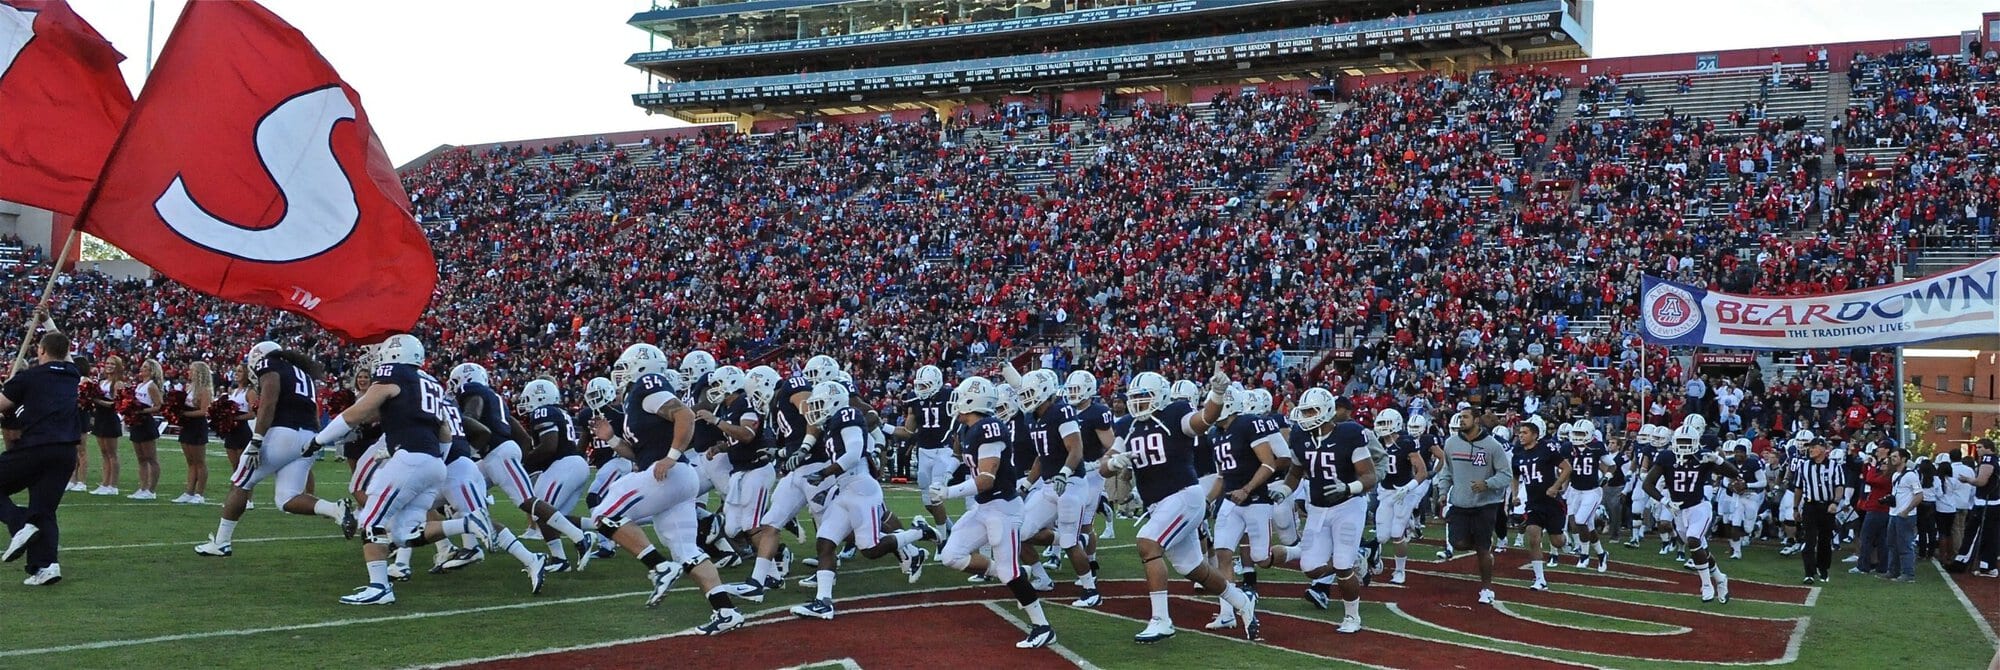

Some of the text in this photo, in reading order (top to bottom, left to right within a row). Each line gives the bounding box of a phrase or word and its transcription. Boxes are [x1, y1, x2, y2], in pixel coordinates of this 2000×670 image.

[1698, 60, 1716, 72] 24
[154, 84, 360, 262] S
[290, 286, 321, 311] TM
[1788, 321, 1911, 340] THE TRADITION LIVES
[376, 364, 394, 378] 62
[641, 376, 663, 391] 54
[789, 377, 806, 390] 90
[534, 407, 548, 419] 20
[840, 408, 856, 424] 27
[922, 407, 940, 429] 11
[1060, 405, 1074, 420] 77
[982, 422, 1001, 439] 38
[1030, 430, 1050, 458] 77
[1130, 432, 1167, 470] 99
[1214, 442, 1238, 472] 15
[1304, 451, 1337, 480] 75
[1473, 452, 1487, 467] A
[1572, 456, 1593, 476] 46
[1673, 471, 1699, 493] 27
